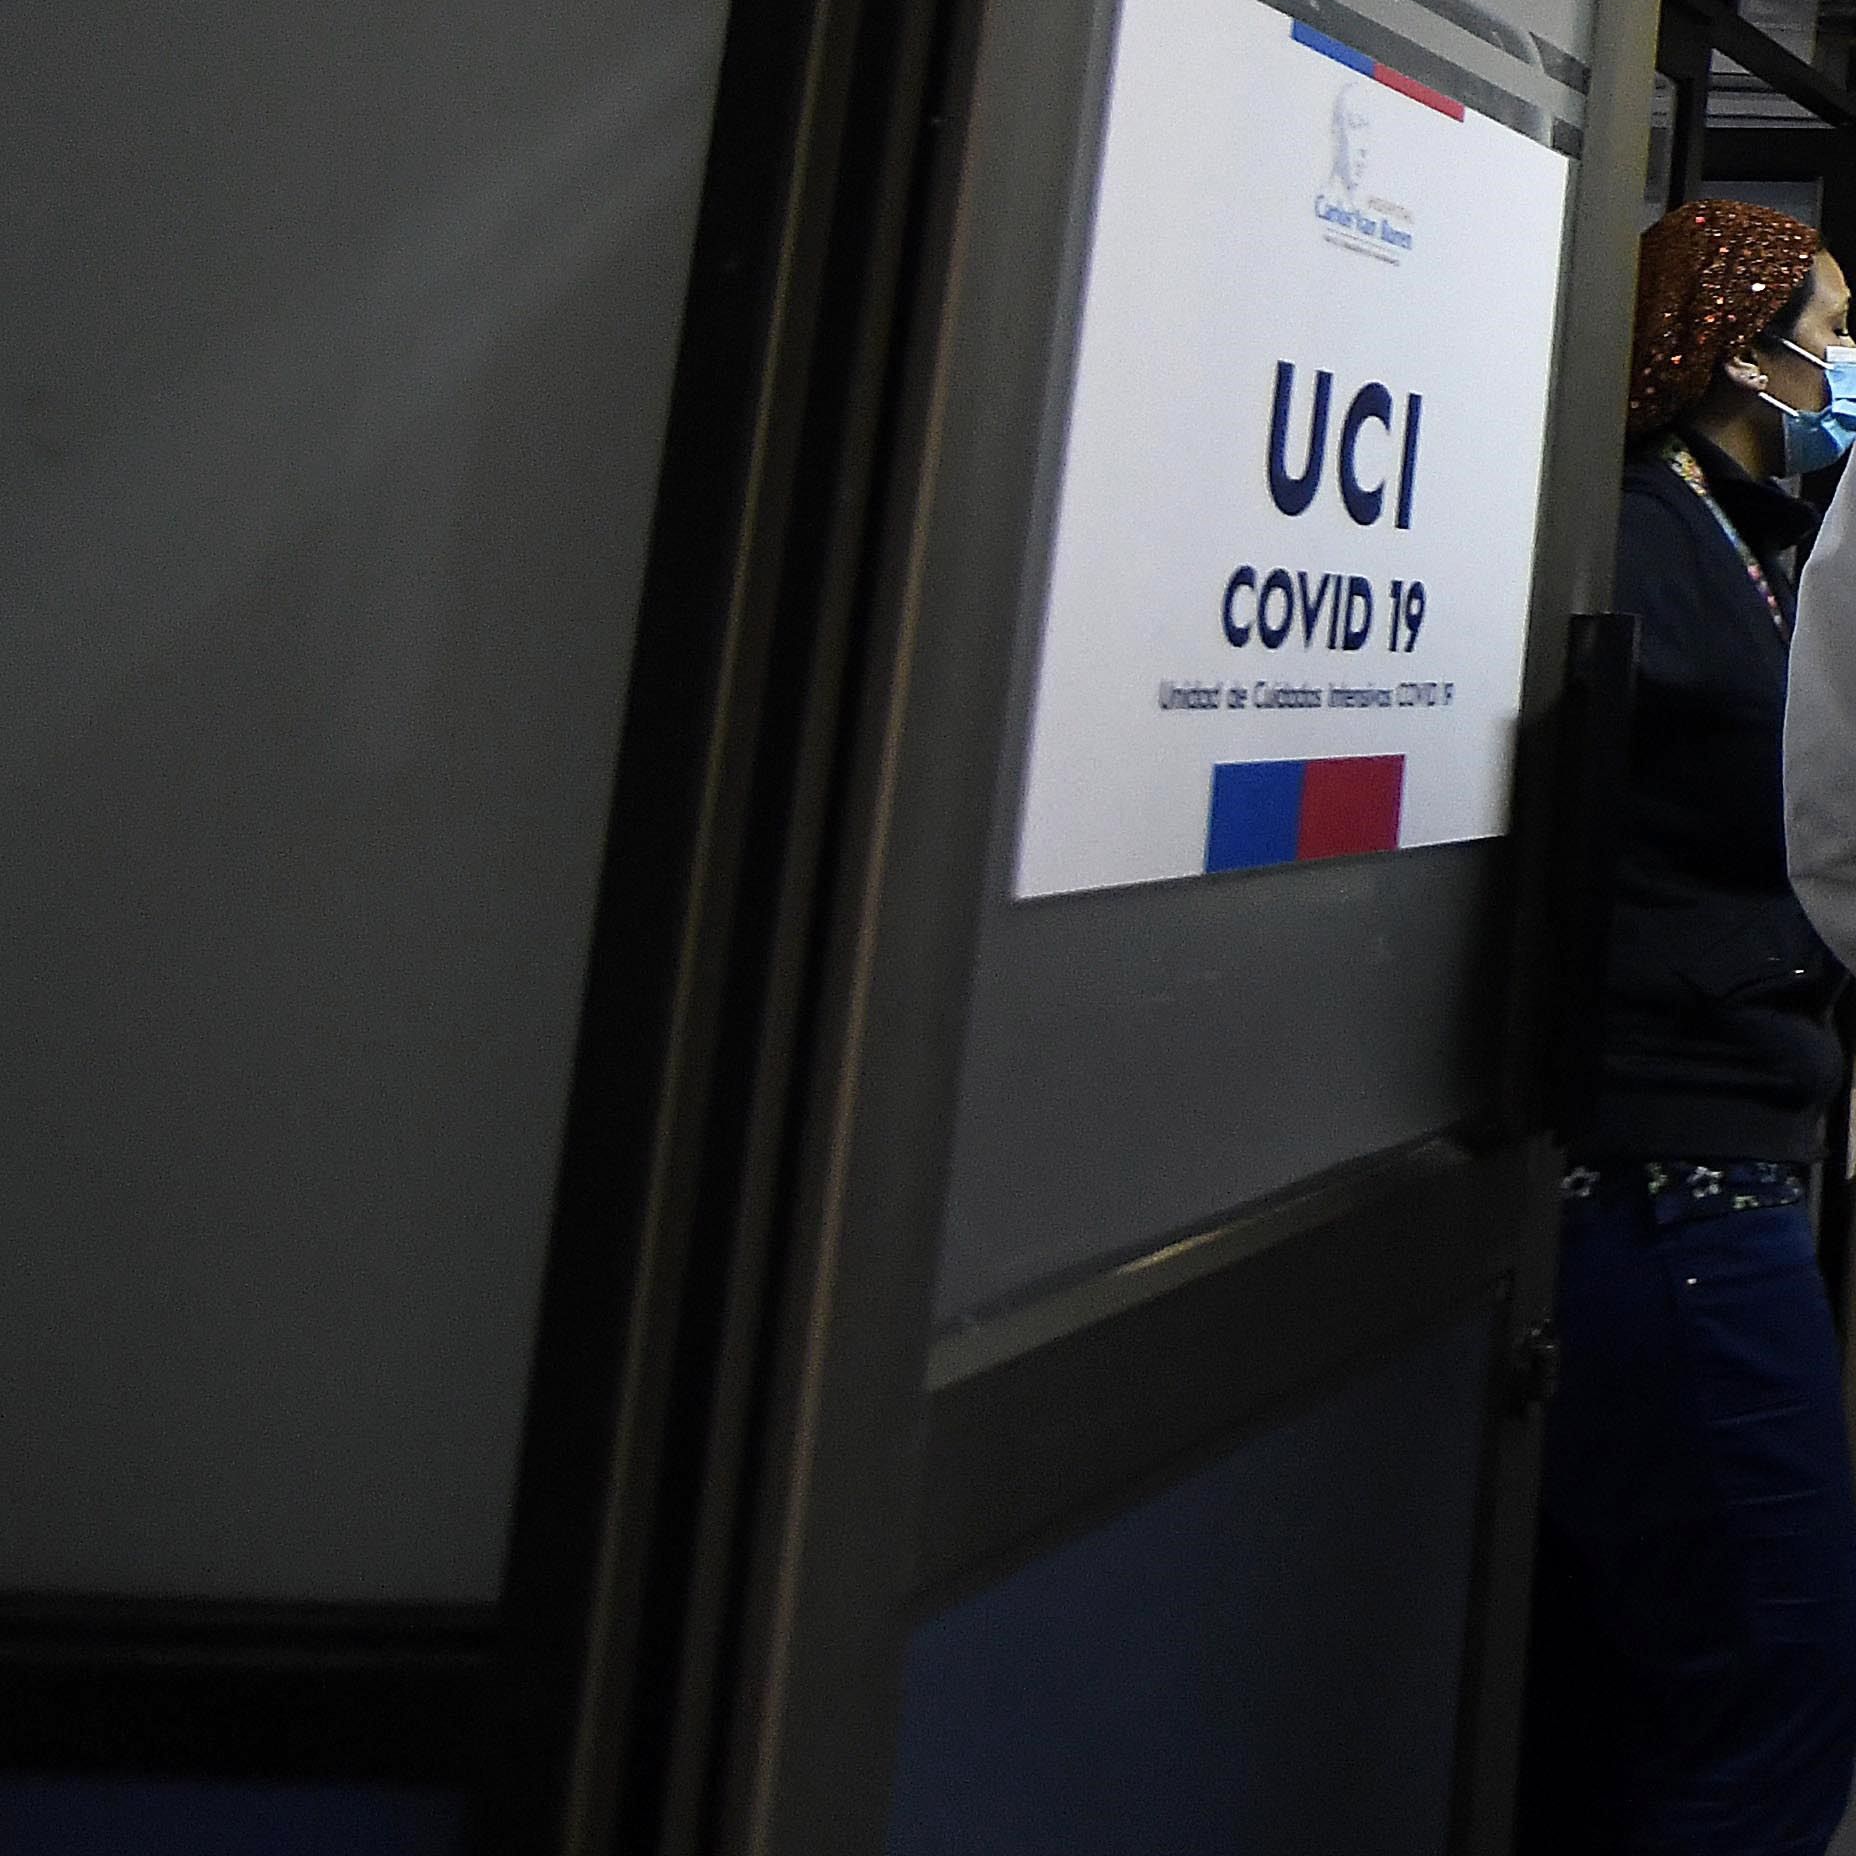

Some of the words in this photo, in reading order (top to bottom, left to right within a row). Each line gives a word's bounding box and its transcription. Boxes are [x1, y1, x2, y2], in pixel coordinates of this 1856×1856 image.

[1266, 360, 1422, 530] UCI
[1221, 565, 1374, 652] COVID
[1388, 580, 1427, 653] 19
